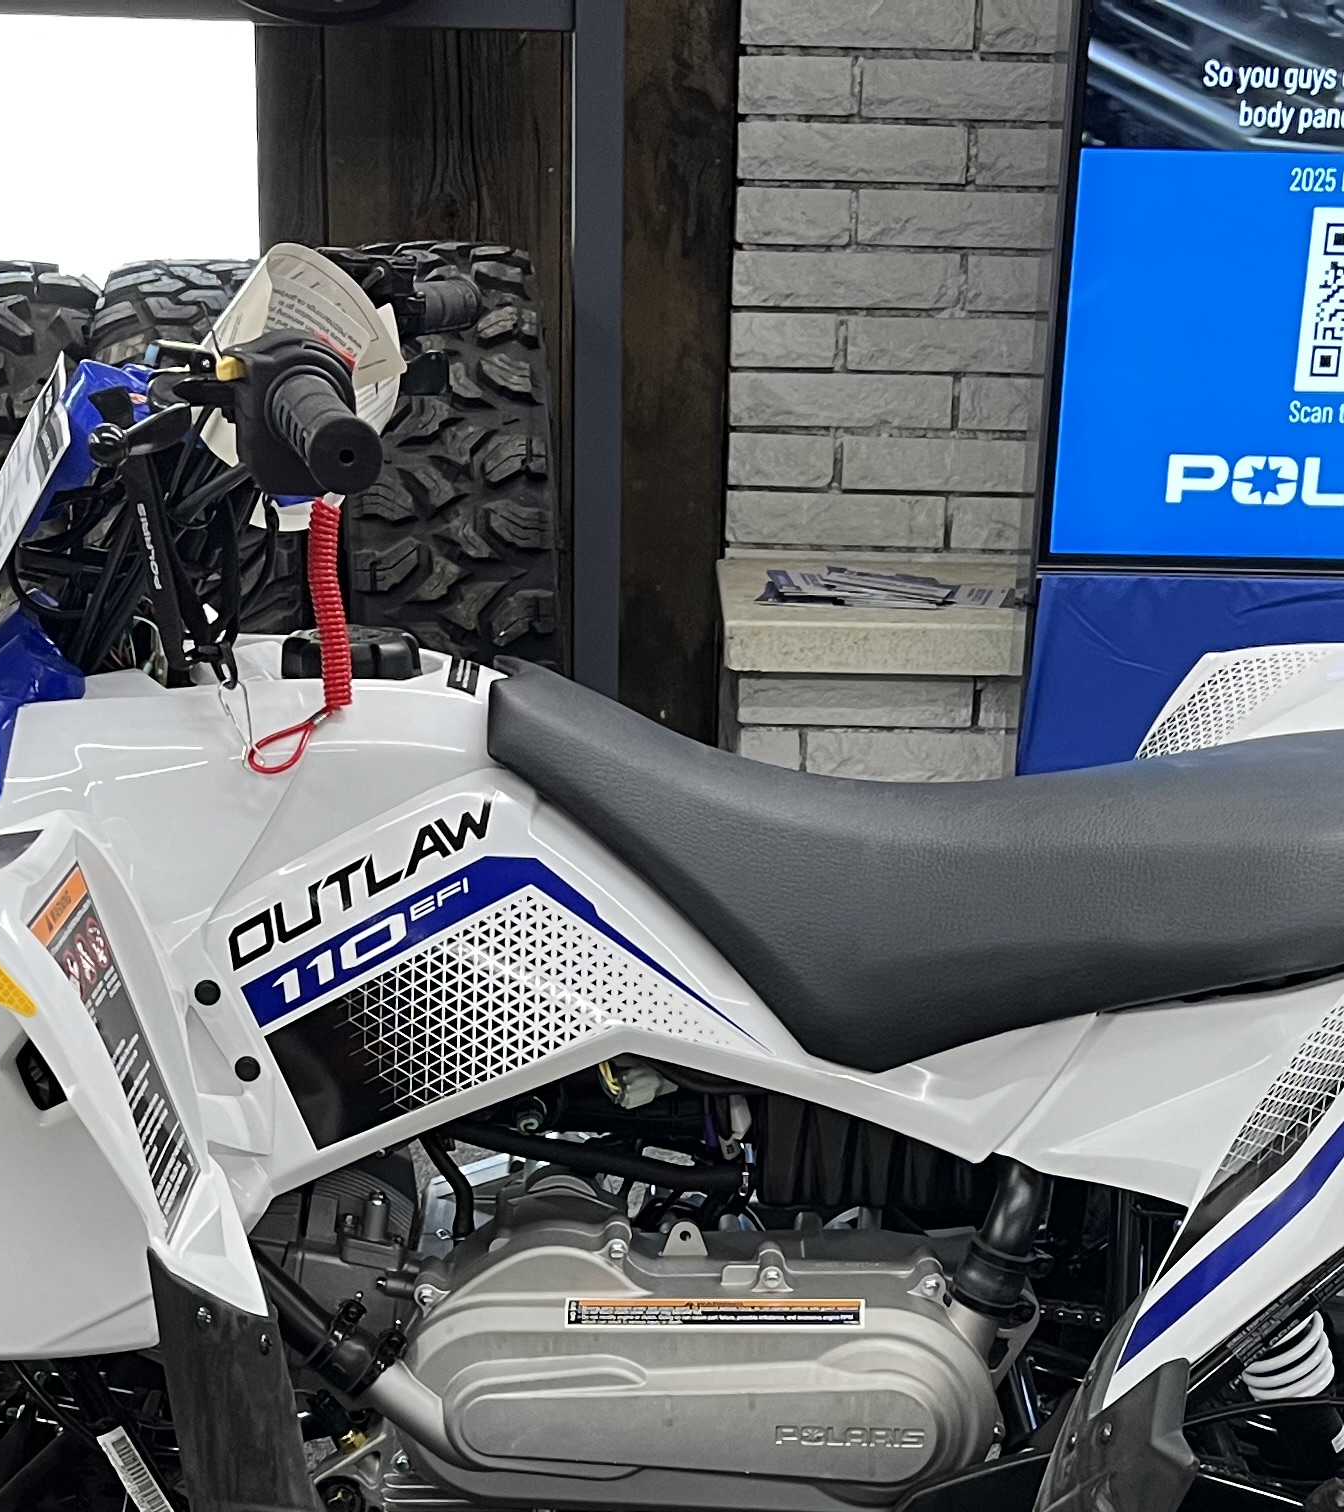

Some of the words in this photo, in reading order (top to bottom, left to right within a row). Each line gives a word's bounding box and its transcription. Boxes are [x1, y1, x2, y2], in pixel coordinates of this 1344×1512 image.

[1203, 59, 1233, 88] So
[1236, 65, 1279, 95] you
[1286, 65, 1338, 97] guys
[1238, 99, 1294, 135] body
[1289, 167, 1338, 193] 2025
[1289, 400, 1334, 425] Scan
[137, 503, 163, 590] POLARIS
[228, 799, 493, 972] OUTLAW
[272, 912, 408, 1004] 110
[409, 877, 470, 922] EFI
[775, 1425, 925, 1448] POLARIS
